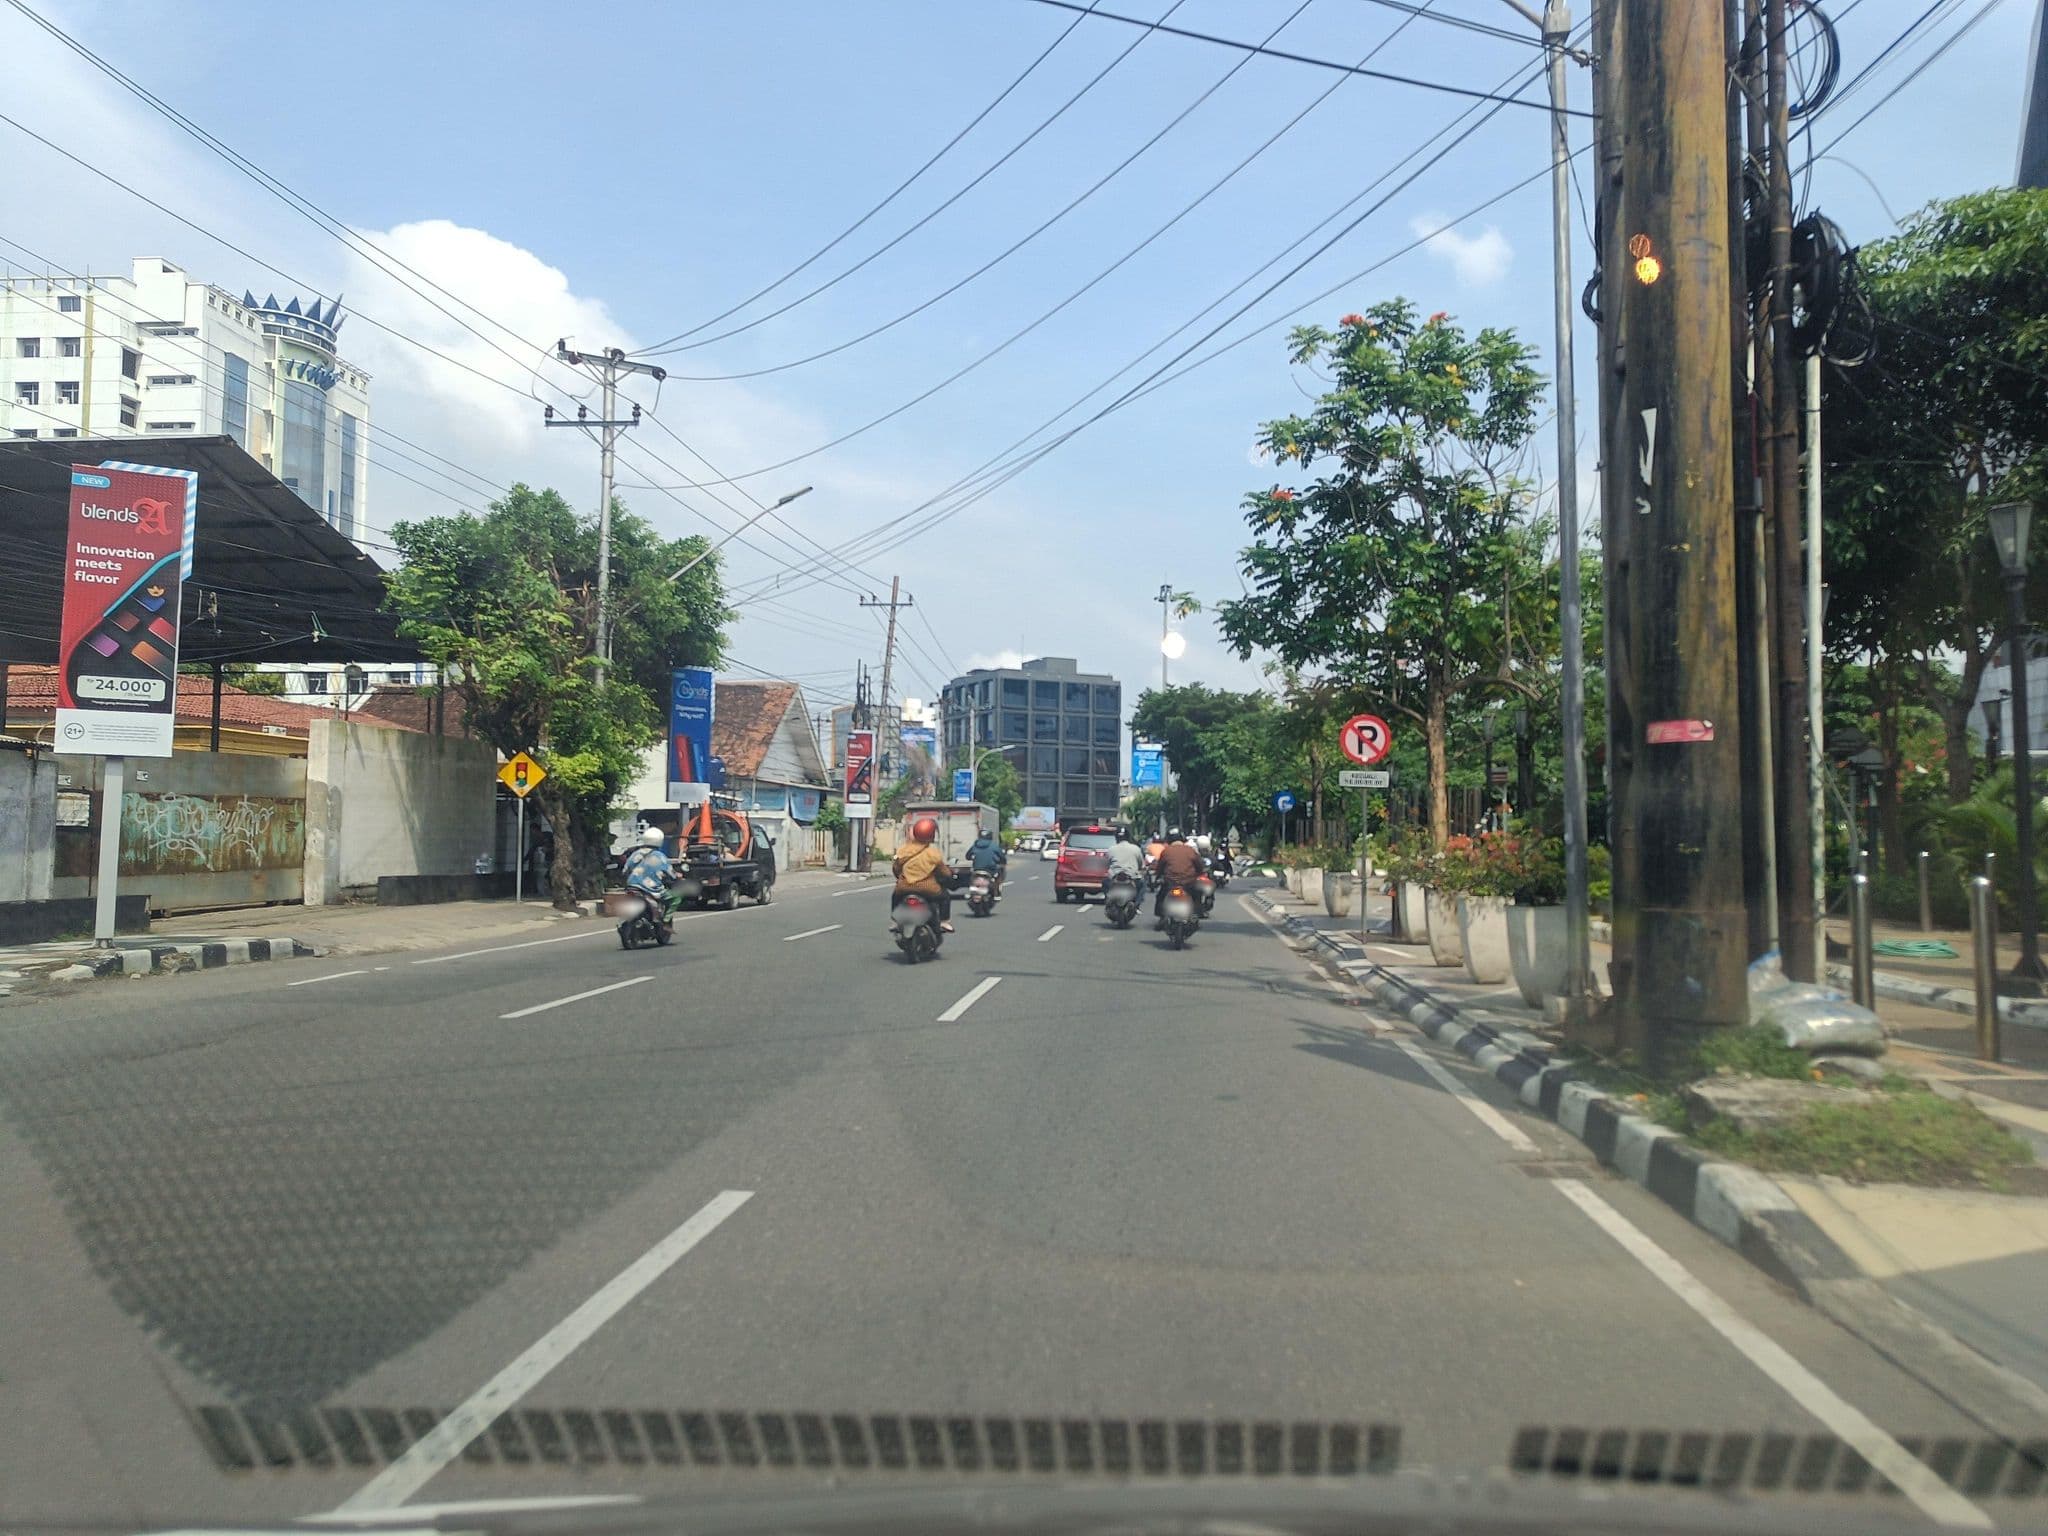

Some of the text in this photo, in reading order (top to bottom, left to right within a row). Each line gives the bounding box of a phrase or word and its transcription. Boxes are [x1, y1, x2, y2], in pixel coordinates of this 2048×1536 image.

[81, 476, 105, 486] NEW
[81, 502, 139, 524] blends
[76, 542, 155, 561] Innovation
[75, 558, 122, 571] meets
[73, 570, 120, 585] flavor
[67, 727, 83, 735] 21+
[1357, 725, 1378, 755] P
